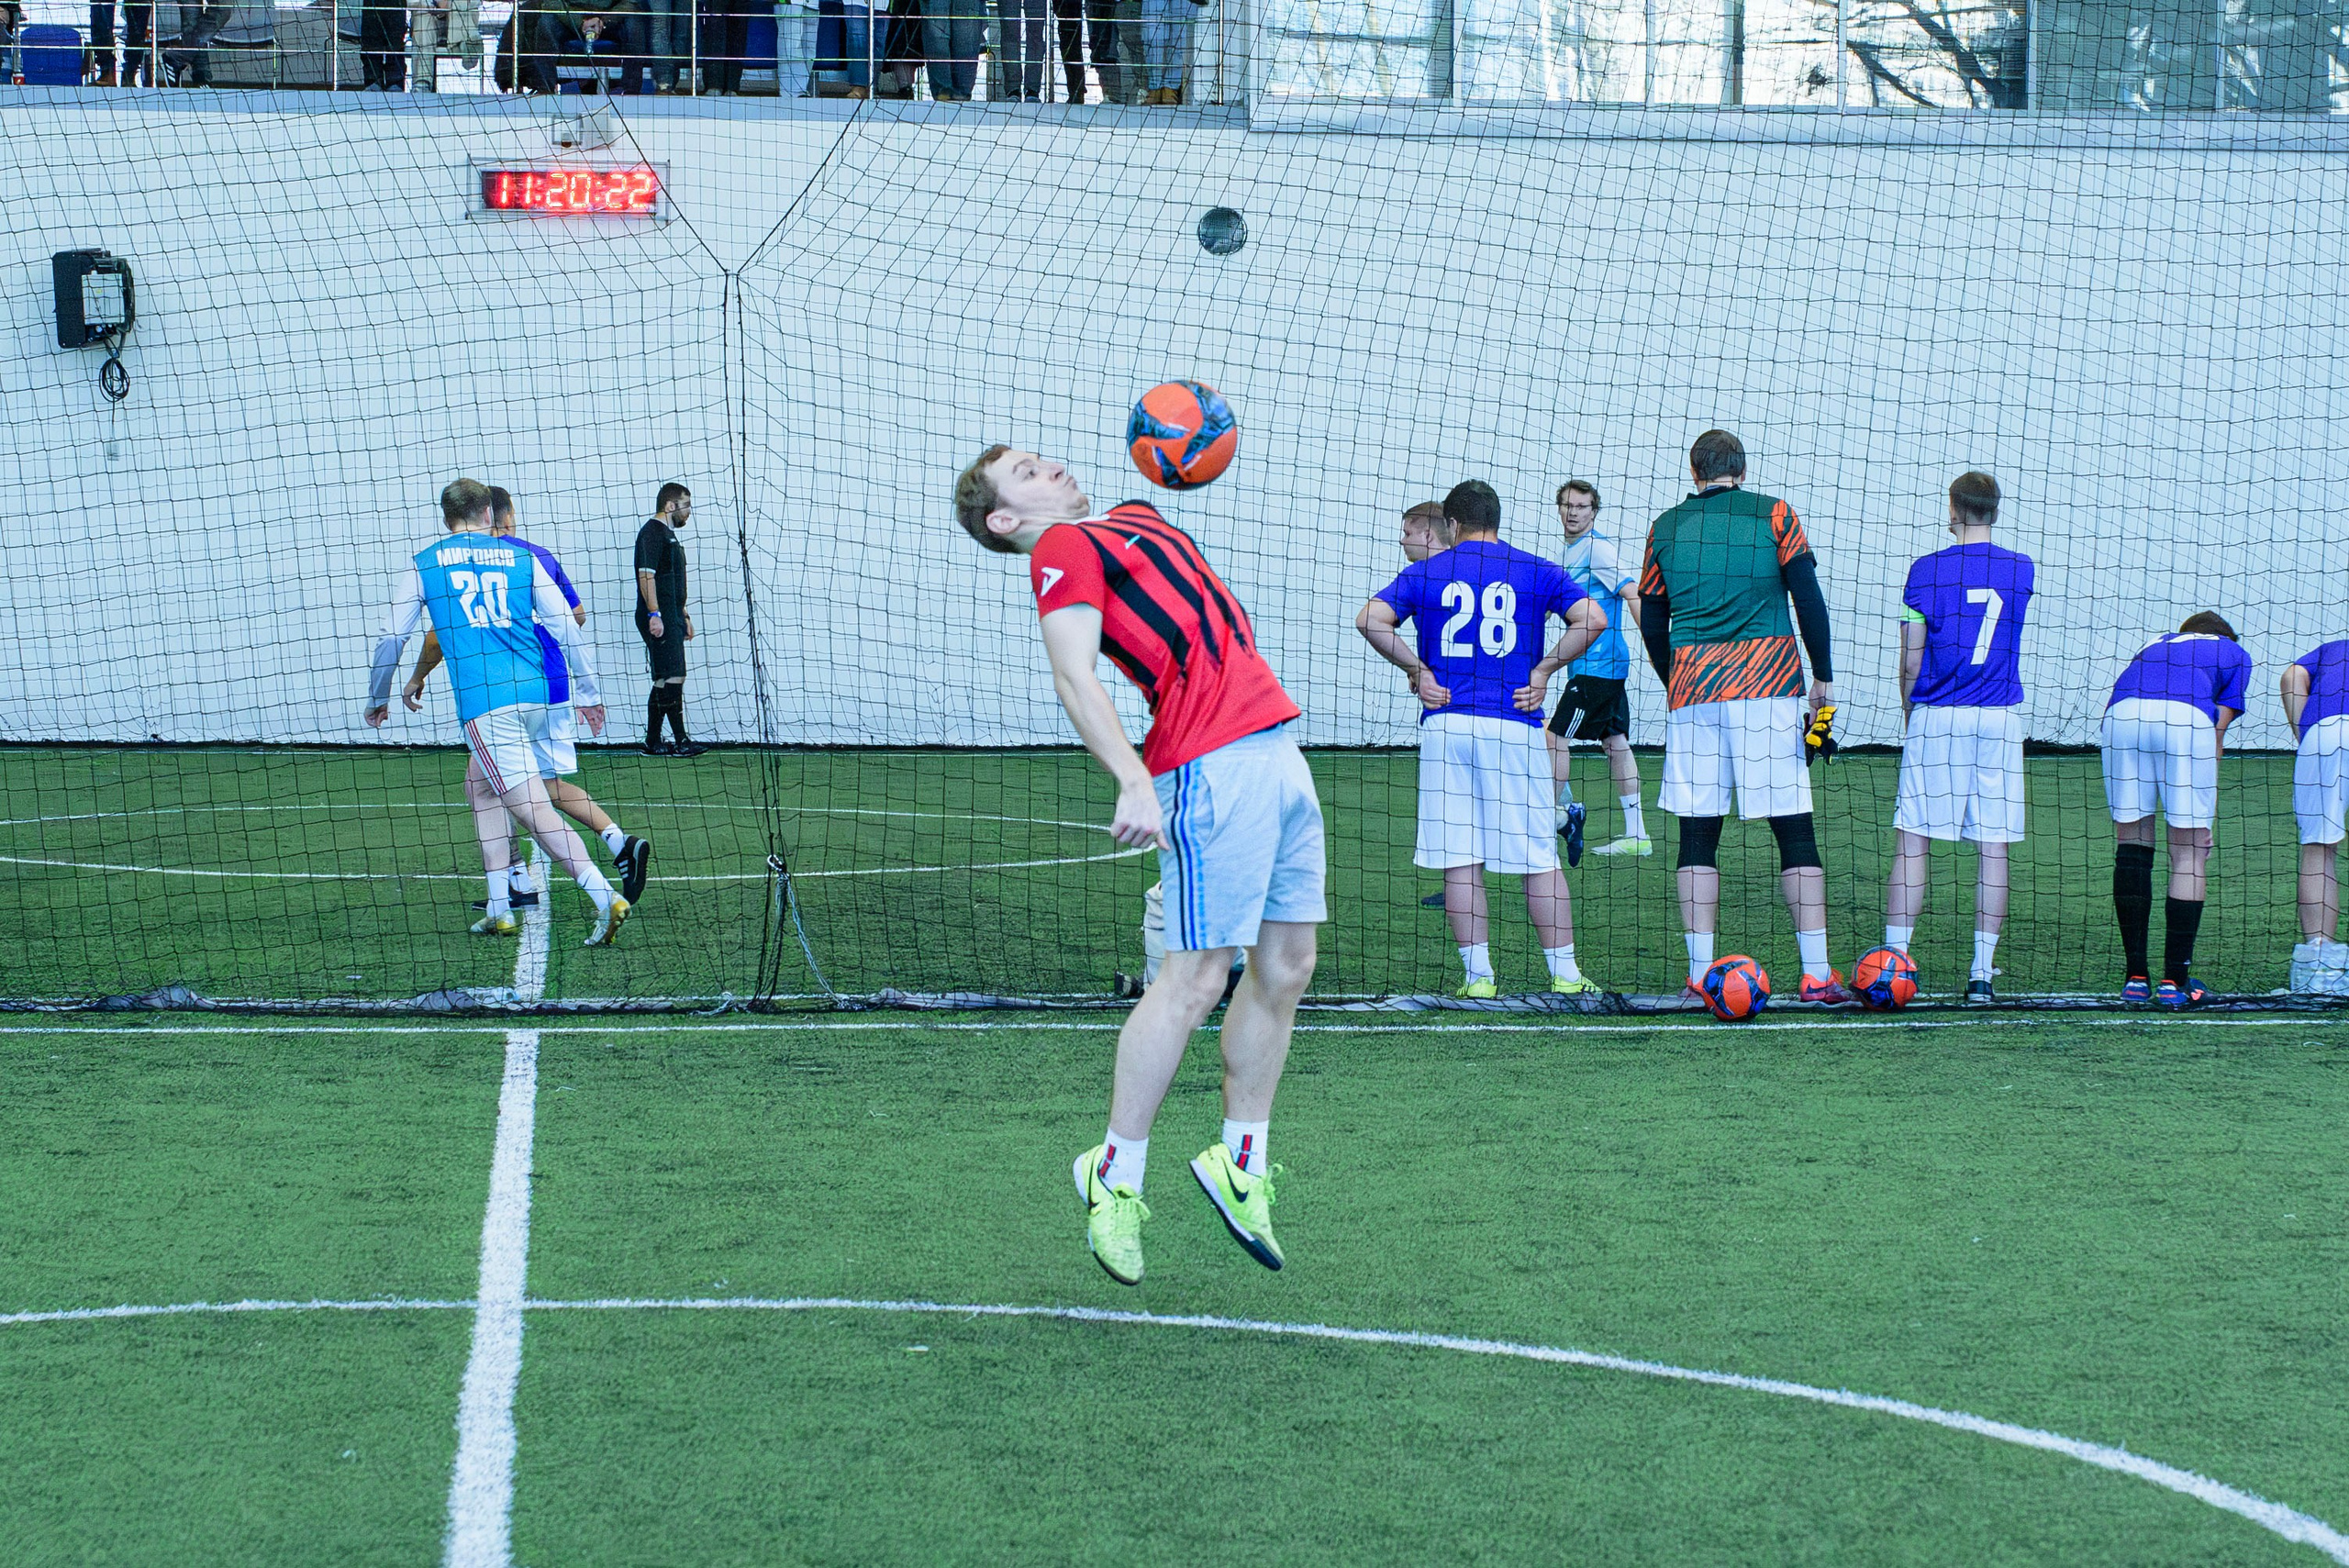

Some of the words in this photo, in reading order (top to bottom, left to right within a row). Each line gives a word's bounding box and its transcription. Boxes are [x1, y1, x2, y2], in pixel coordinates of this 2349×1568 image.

[501, 173, 651, 208] 11:20:22
[436, 547, 516, 568] МИРОНОВ
[450, 570, 512, 628] 20
[1441, 580, 1517, 659] 28
[1966, 588, 2004, 665] 7
